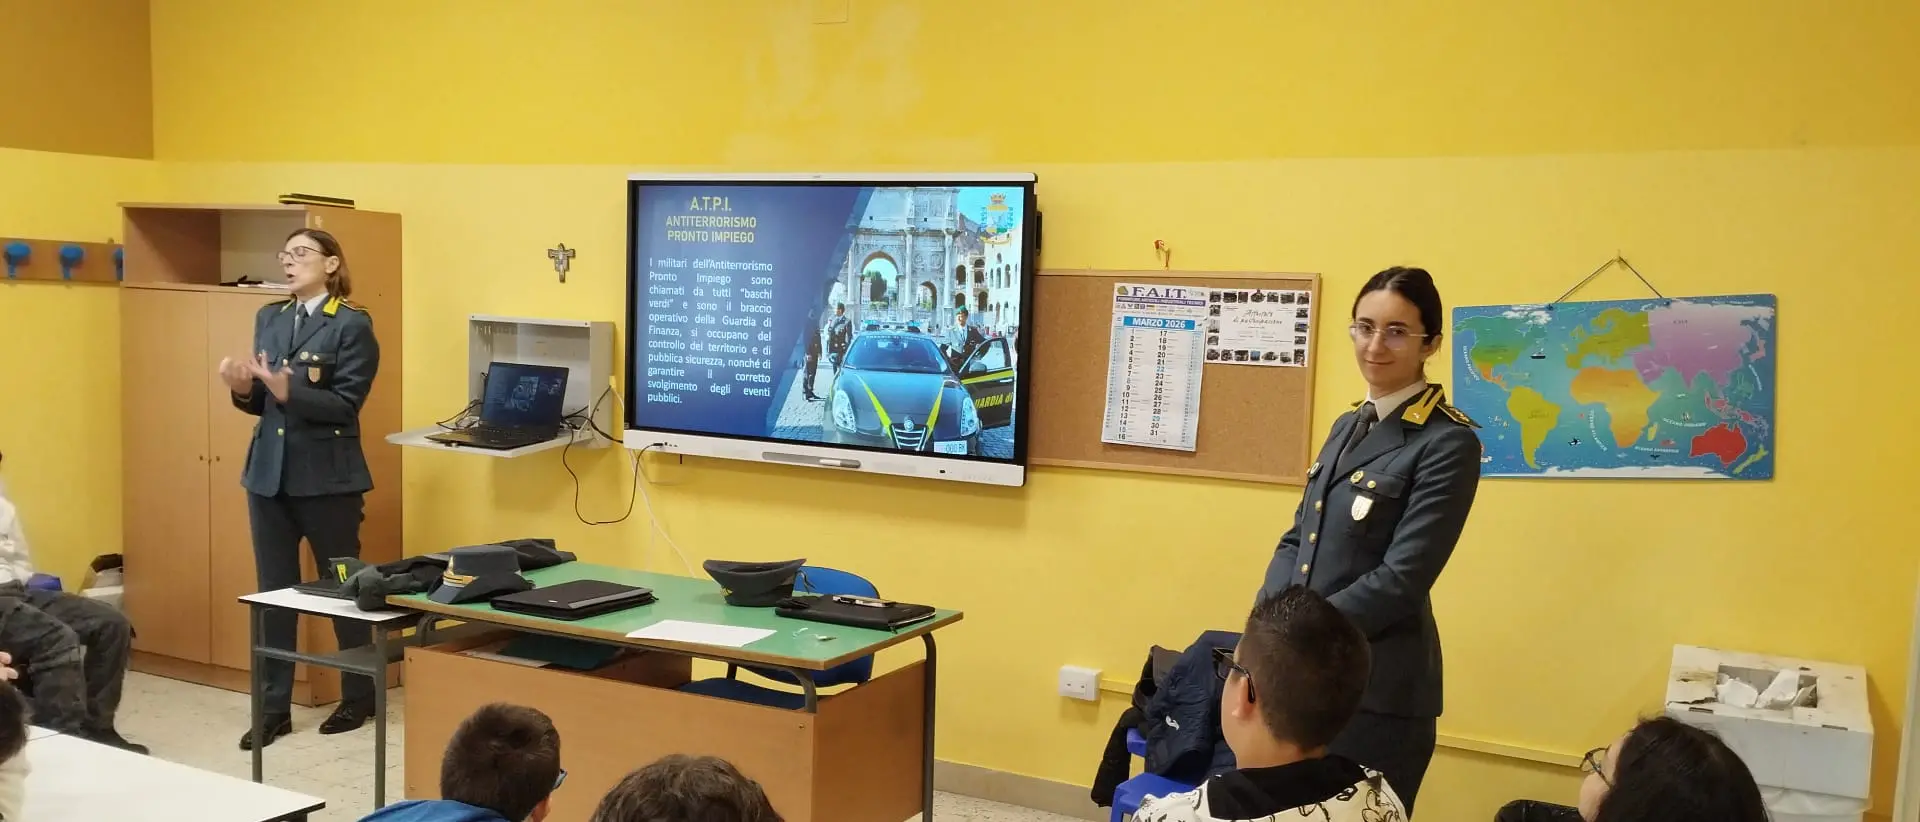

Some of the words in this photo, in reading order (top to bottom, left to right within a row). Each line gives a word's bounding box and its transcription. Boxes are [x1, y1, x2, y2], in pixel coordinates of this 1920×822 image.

[690, 196, 732, 211] A.T.P.I.
[666, 216, 756, 228] ANTITERRORISMO
[668, 230, 708, 242] PRONTO
[711, 231, 754, 243] IMPIEGO
[658, 258, 688, 268] militari
[693, 258, 773, 271] dell'Antiterrorismo
[649, 272, 677, 281] Pronto
[696, 273, 731, 285] Impiego
[751, 276, 772, 285] sono
[649, 285, 684, 295] chiamati
[693, 287, 704, 296] da
[713, 288, 731, 298] tutti
[1132, 287, 1187, 298] F.A.I.T.
[697, 302, 717, 311] sono
[727, 302, 732, 311] il
[740, 302, 772, 313] braccio
[649, 313, 688, 323] operativo
[695, 314, 715, 324] della
[722, 316, 756, 327] Guardia
[763, 317, 771, 327] di
[1132, 318, 1163, 326] MARZO
[1165, 320, 1186, 328] 2026
[649, 325, 682, 337] Finanza,
[691, 328, 698, 337] si
[707, 331, 748, 340] occupano
[758, 331, 771, 341] del
[649, 340, 685, 350] controllo
[690, 341, 703, 351] del
[708, 343, 747, 353] territorio
[763, 345, 770, 355] di
[649, 354, 683, 364] pubblica
[685, 355, 725, 368] sicurezza,
[728, 359, 760, 369] nonché
[763, 359, 770, 369] di
[648, 367, 684, 377] garantire
[708, 369, 713, 379] il
[736, 372, 770, 383] corretto
[648, 380, 698, 392] svolgimento
[710, 384, 730, 396] degli
[744, 387, 770, 396] eventi
[648, 393, 683, 404] pubblici.
[976, 393, 1004, 408] UARDIA
